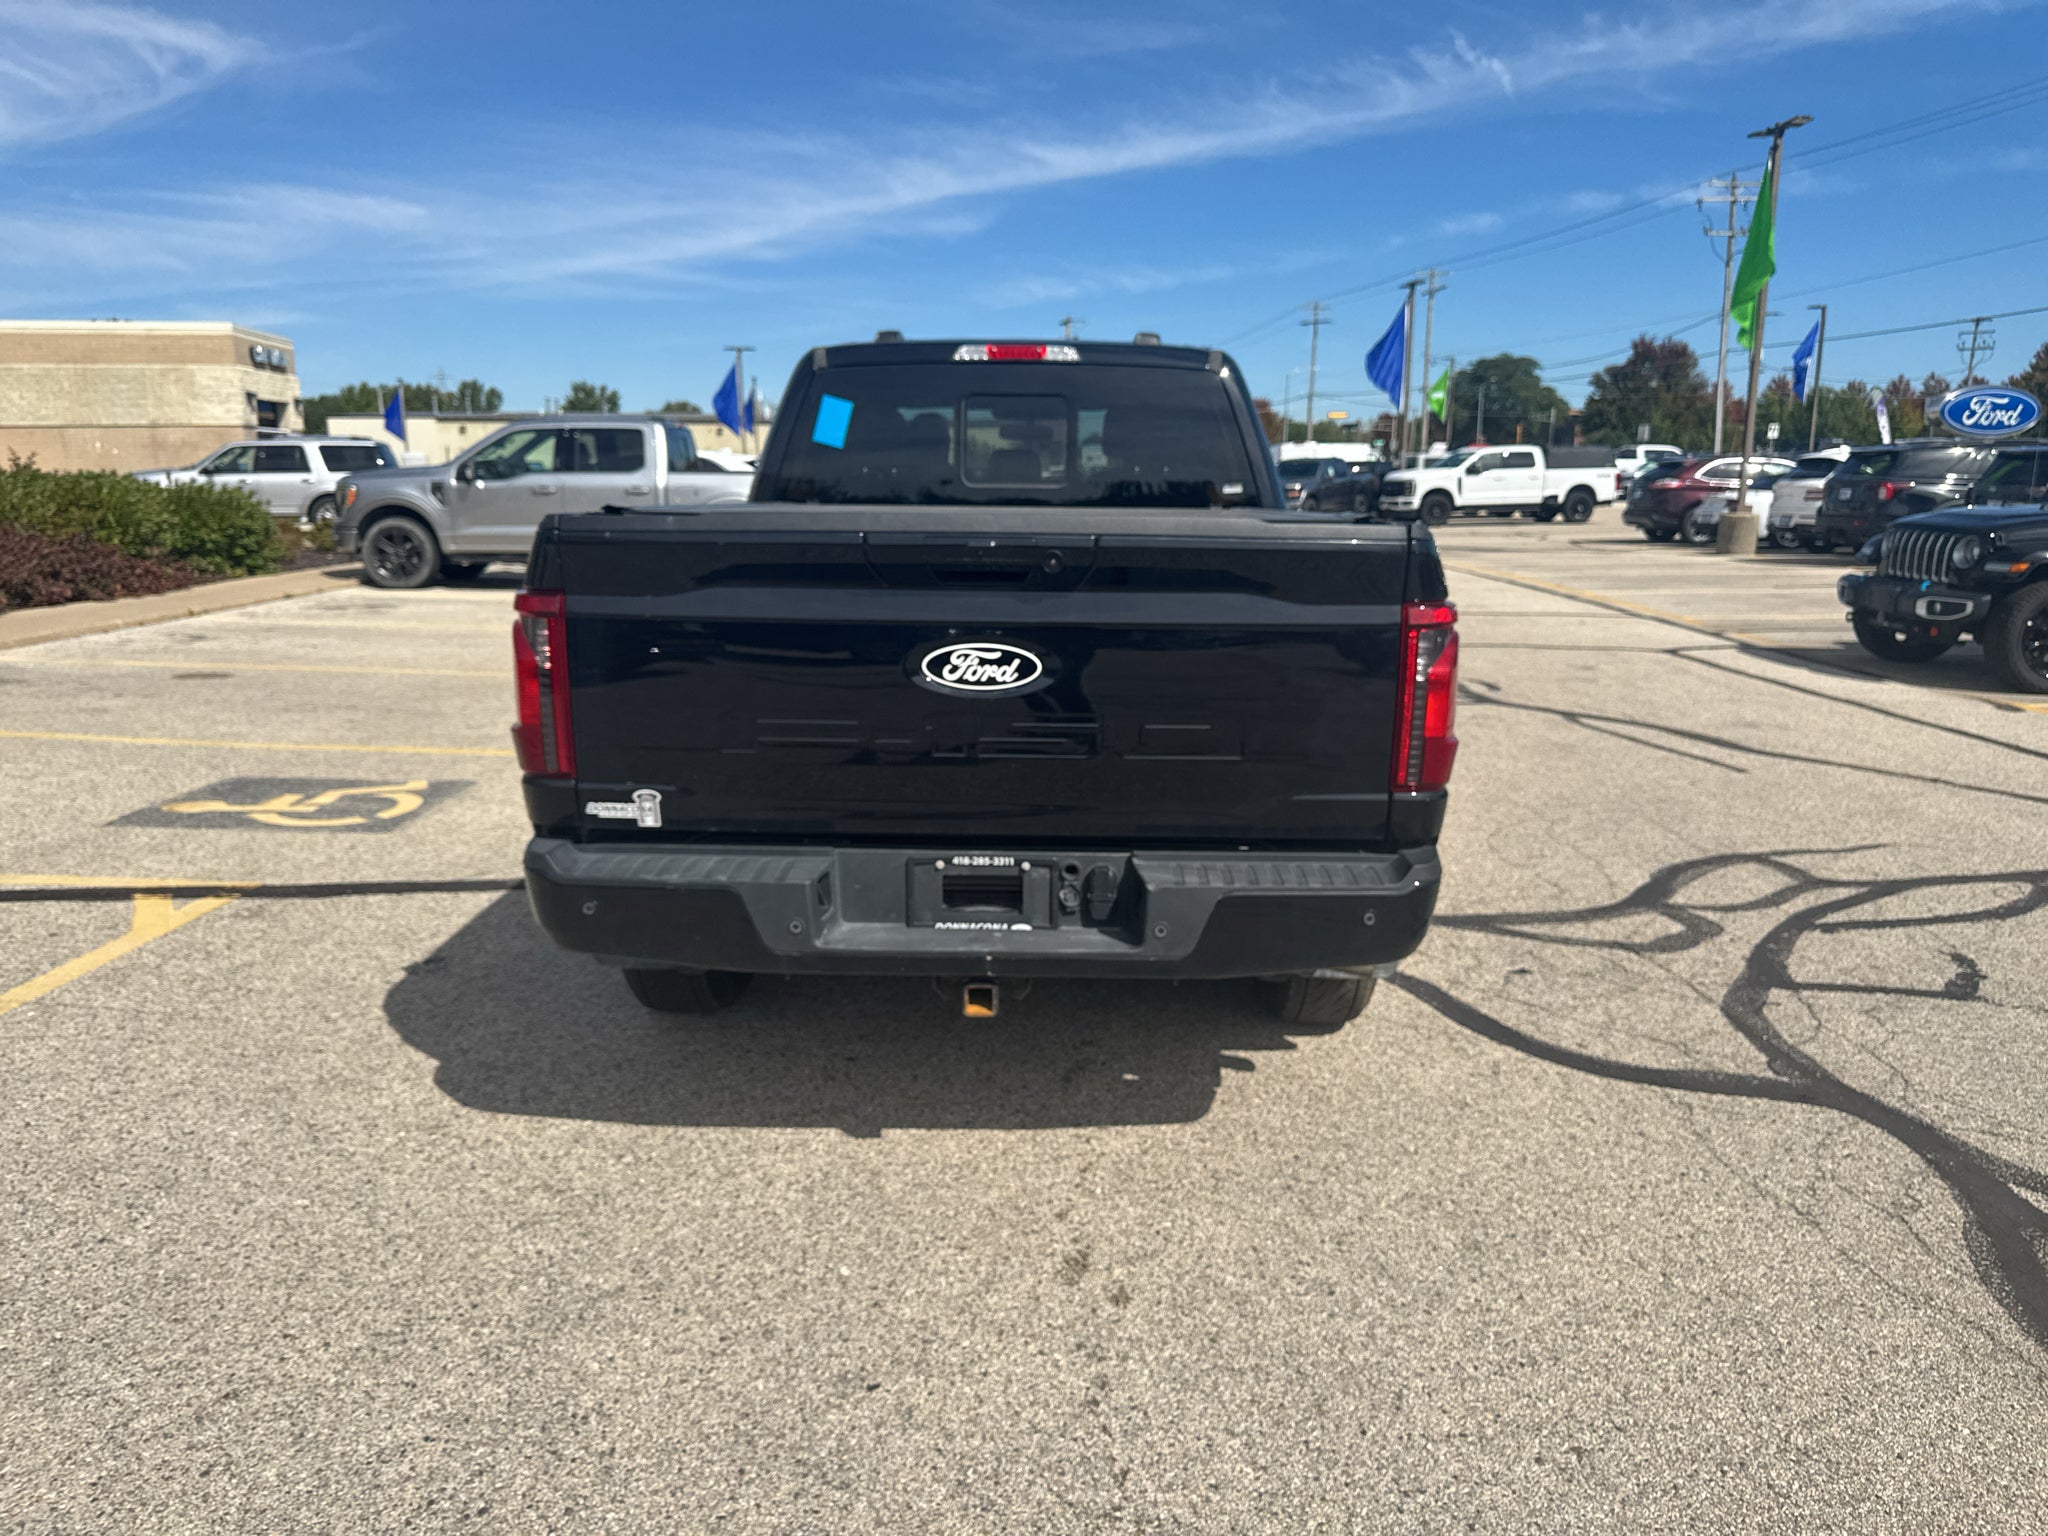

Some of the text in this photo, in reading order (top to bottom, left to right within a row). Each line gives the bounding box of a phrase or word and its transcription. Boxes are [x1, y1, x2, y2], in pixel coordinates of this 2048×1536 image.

[1962, 395, 2024, 426] Ford
[942, 649, 1021, 683] Ford
[952, 856, 1015, 866] 418-285-3311
